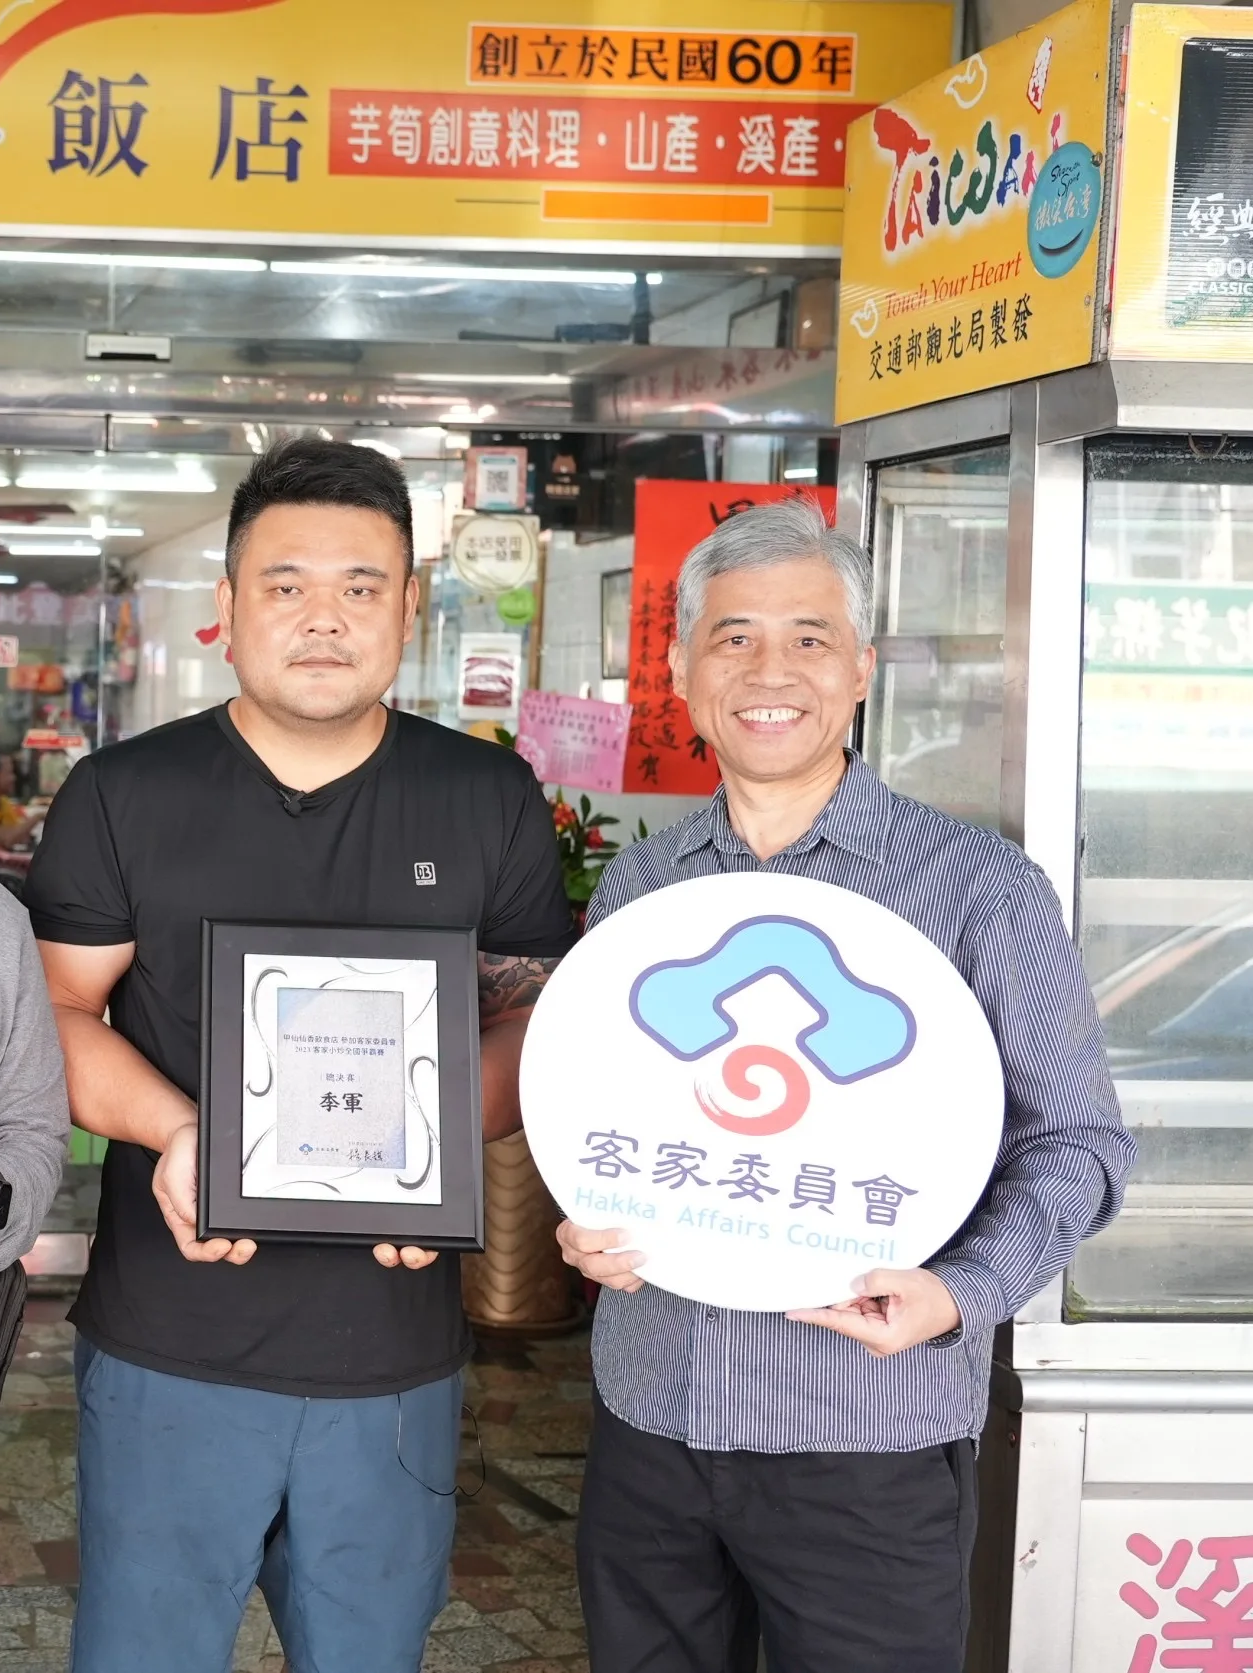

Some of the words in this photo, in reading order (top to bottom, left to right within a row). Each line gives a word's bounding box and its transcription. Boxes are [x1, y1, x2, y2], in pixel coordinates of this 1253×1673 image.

[477, 32, 853, 86] 創立於民國60年
[46, 69, 311, 184] 飯店
[885, 281, 928, 320] Touch
[930, 276, 968, 301] Your
[969, 251, 1022, 292] Heart
[869, 293, 1033, 381] 交通部觀光局製發
[319, 1091, 363, 1113] 季軍
[578, 1129, 919, 1227] 客家委員會
[574, 1187, 657, 1221] Hakka
[676, 1204, 770, 1240] Affairs
[786, 1222, 897, 1262] Council
